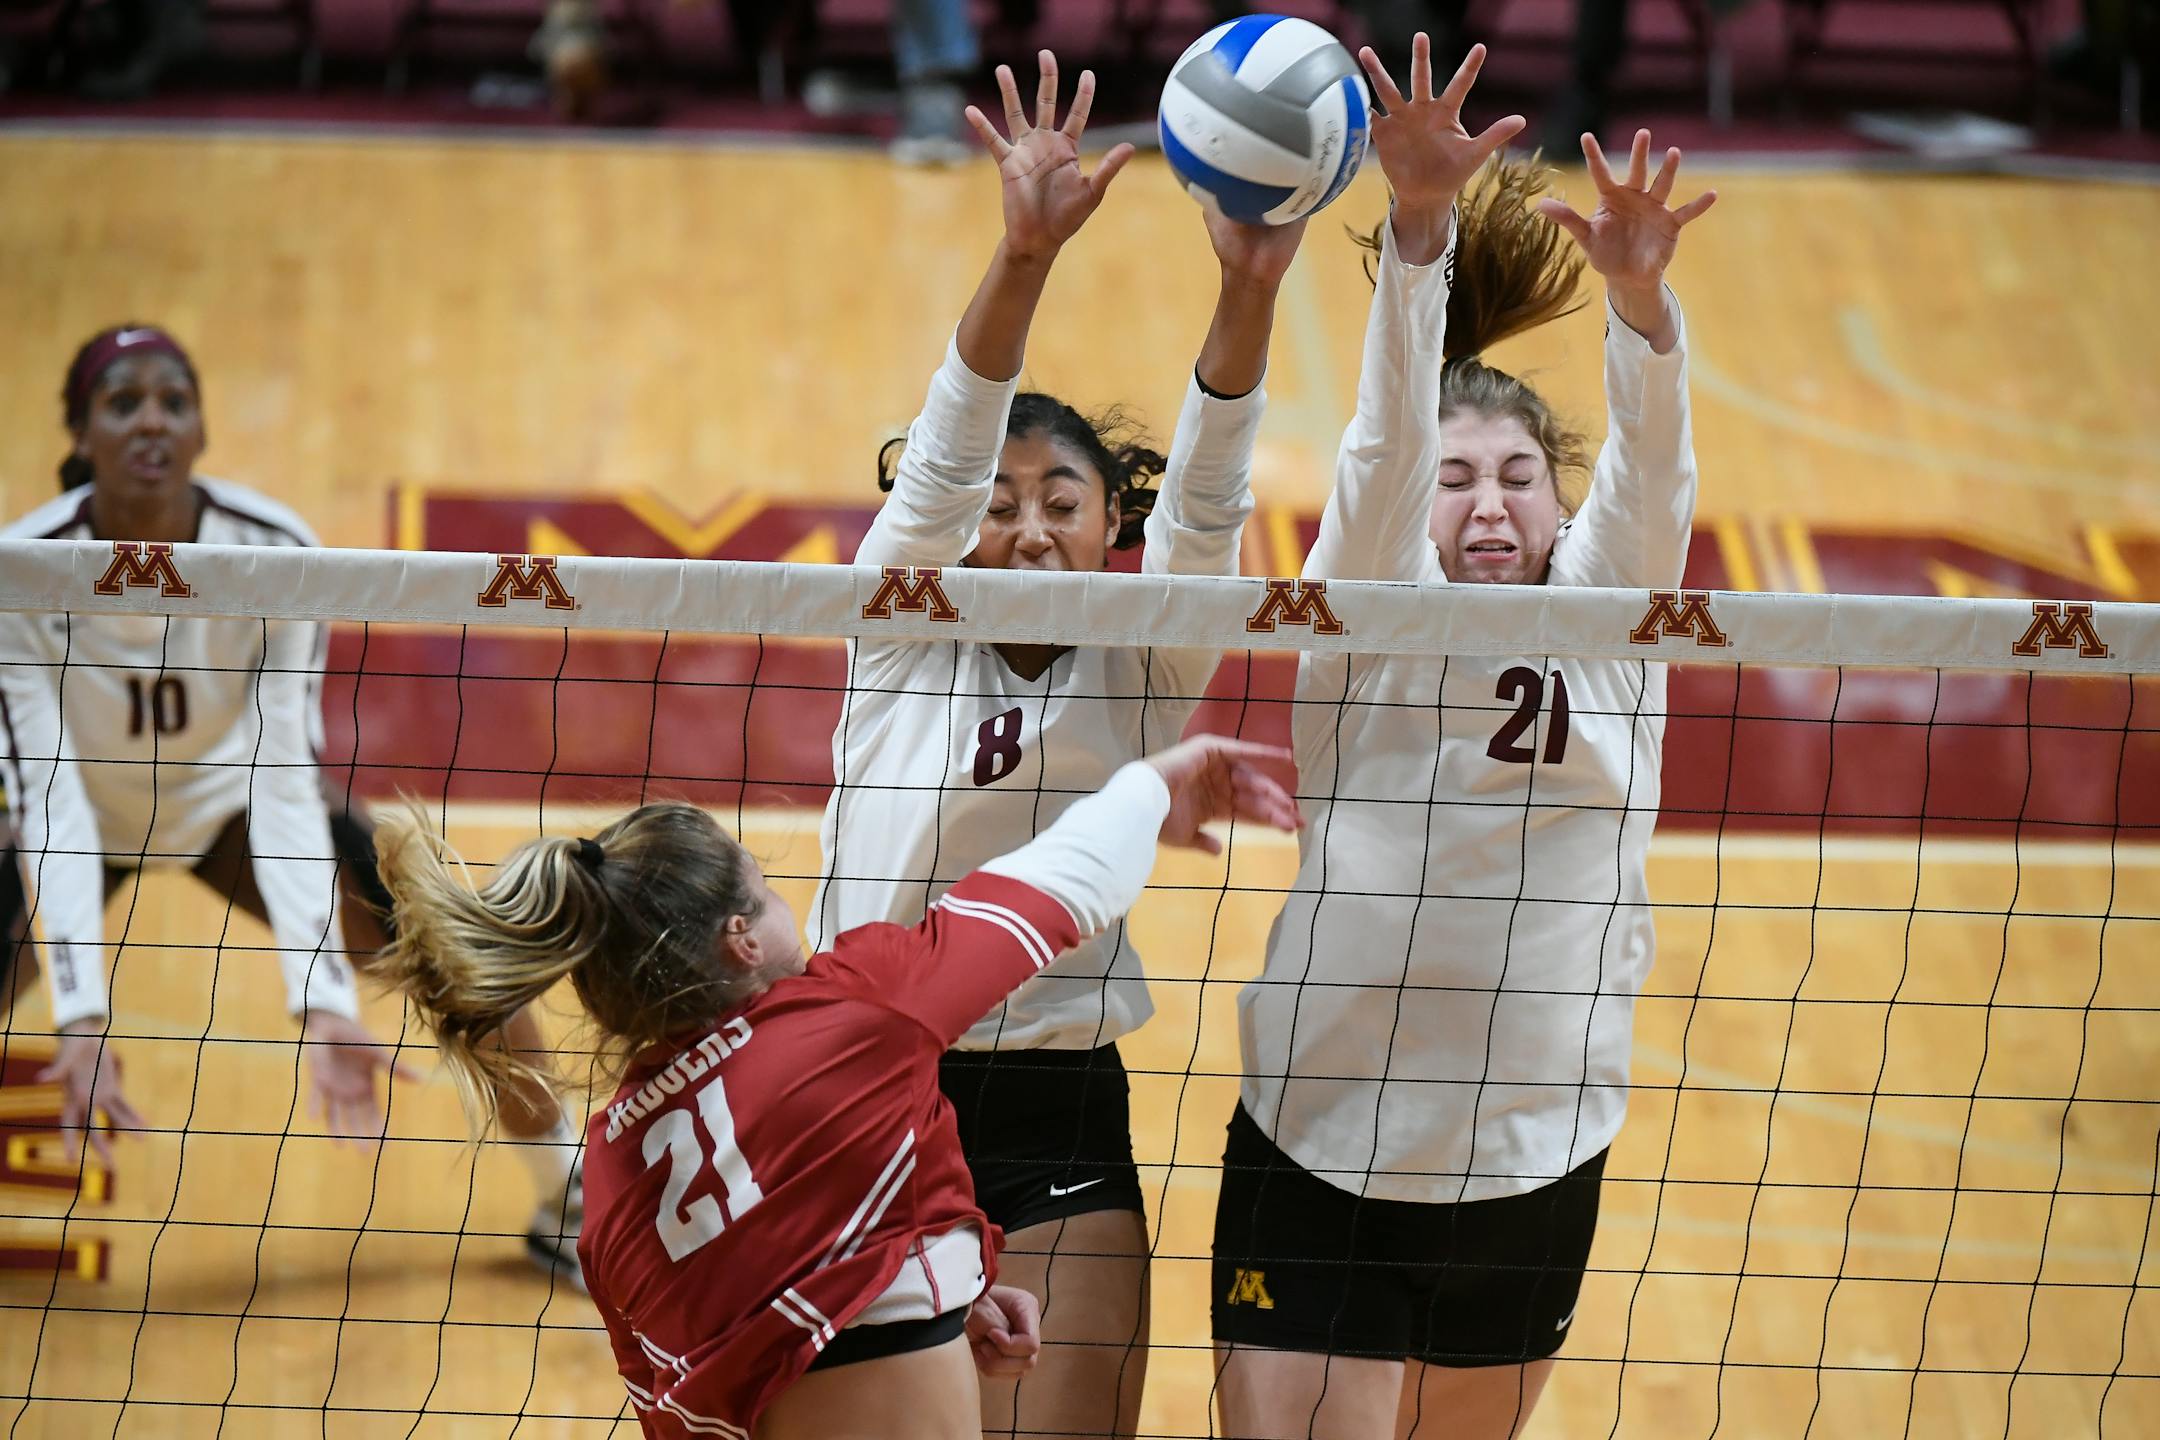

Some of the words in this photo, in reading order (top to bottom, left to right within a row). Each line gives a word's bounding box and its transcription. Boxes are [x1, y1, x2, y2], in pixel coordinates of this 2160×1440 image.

[94, 541, 191, 598] M
[477, 554, 576, 611] M
[862, 566, 959, 622] M
[1246, 578, 1343, 635] M
[1629, 590, 1727, 647] M
[2012, 602, 2109, 658] M
[127, 676, 188, 739] 10
[1486, 666, 1569, 764] 21
[973, 707, 1023, 787] 8
[642, 1075, 764, 1263] 21
